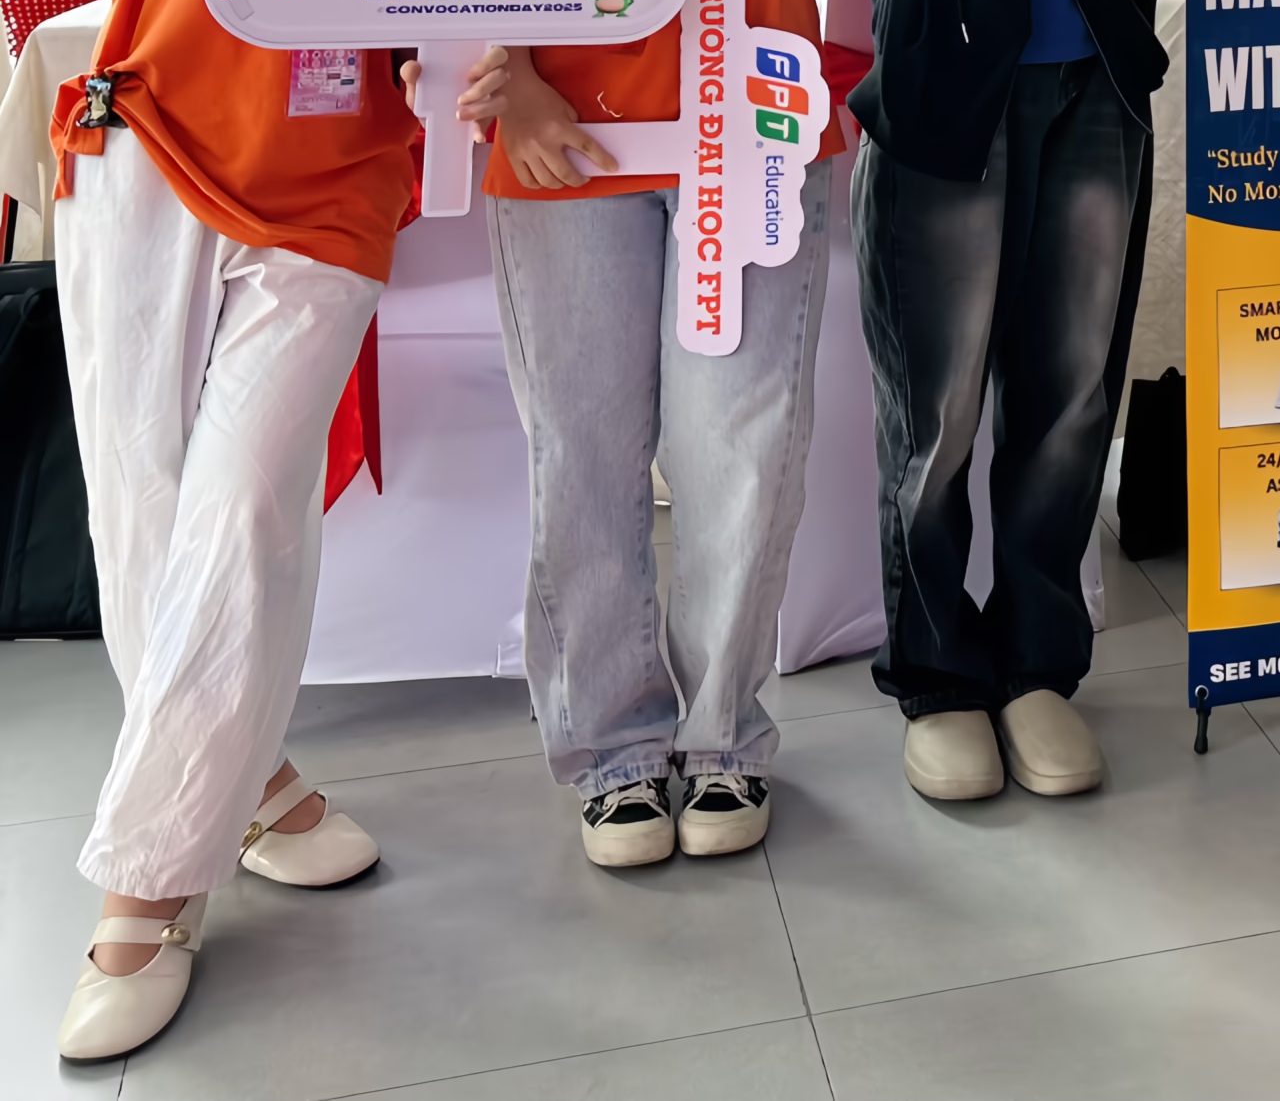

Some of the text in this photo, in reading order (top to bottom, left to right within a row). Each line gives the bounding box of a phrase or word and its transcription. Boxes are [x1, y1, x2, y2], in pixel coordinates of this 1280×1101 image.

[692, 185, 723, 262] HỌC
[764, 155, 785, 246] Education
[1208, 185, 1237, 204] No
[696, 271, 722, 336] FPT
[1209, 662, 1251, 683] SEE
